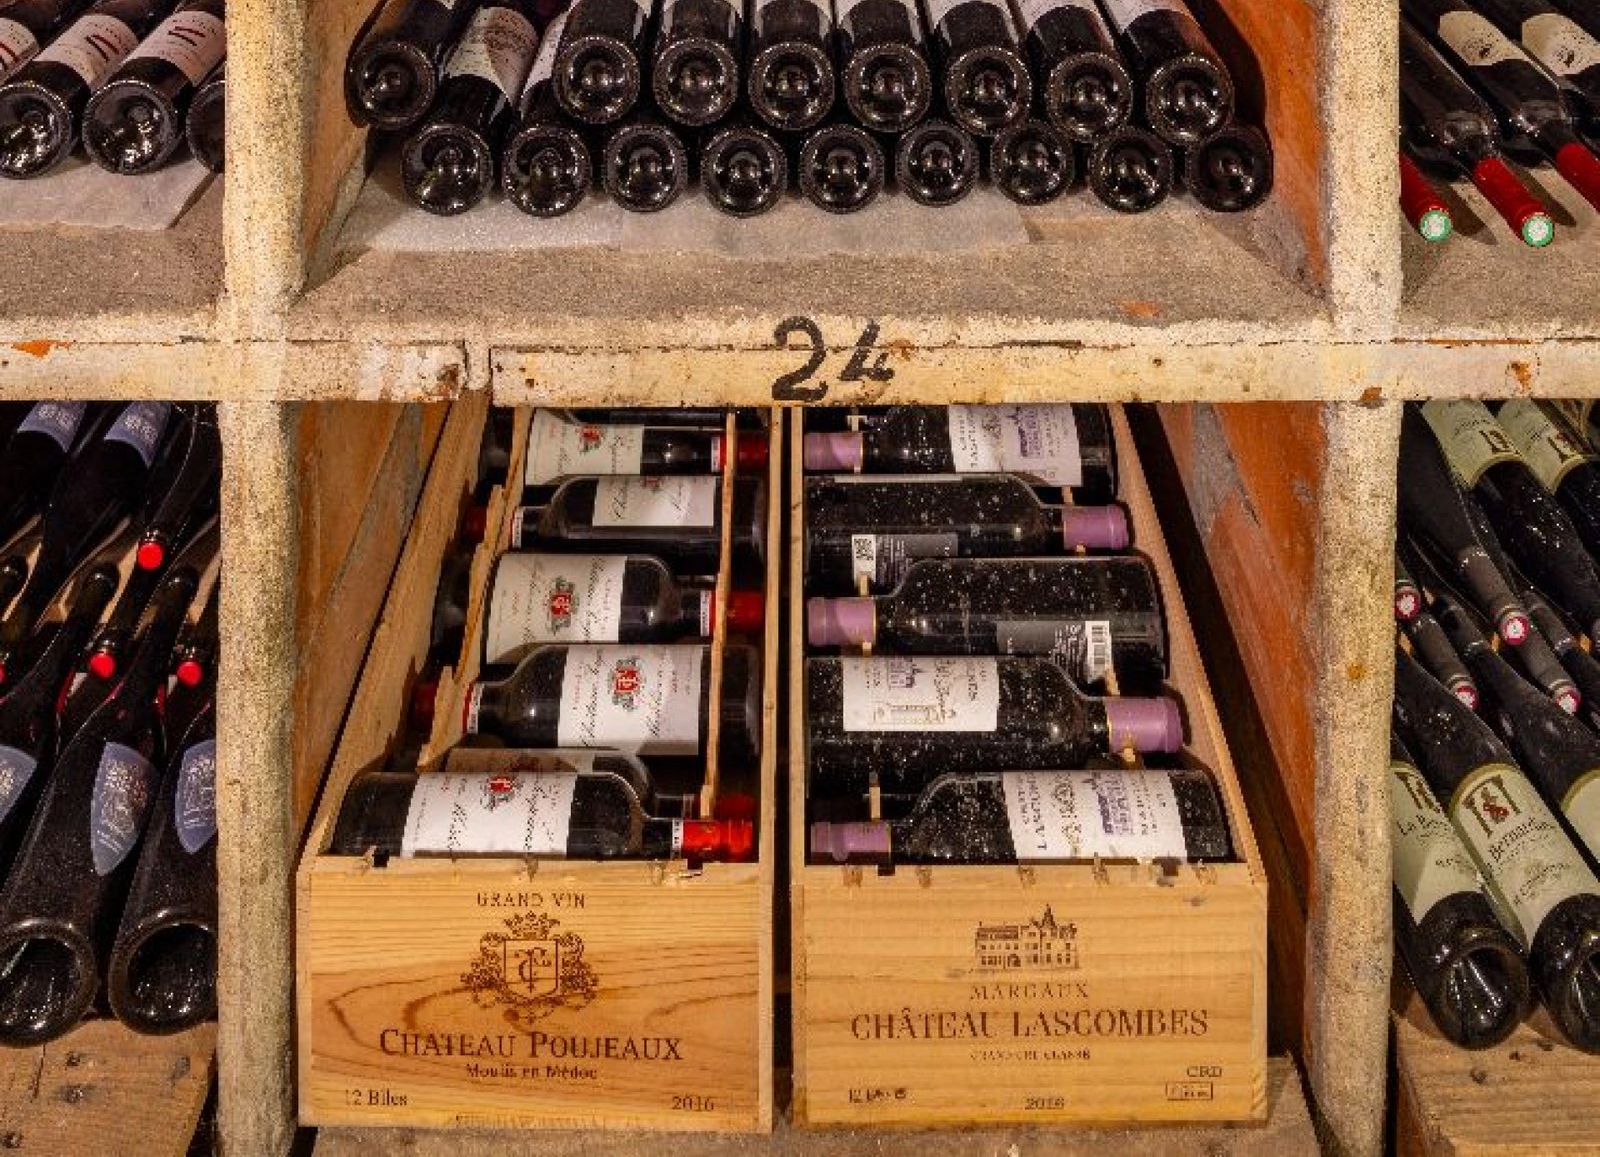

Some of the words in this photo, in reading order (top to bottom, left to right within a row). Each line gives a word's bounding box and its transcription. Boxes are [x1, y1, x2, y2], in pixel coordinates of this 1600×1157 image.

[477, 892, 543, 907] GRAND
[551, 892, 584, 909] VIN
[850, 1007, 998, 1040] CHÂTEAU
[1013, 1009, 1208, 1037] LASCOMBES
[345, 1089, 362, 1106] 12
